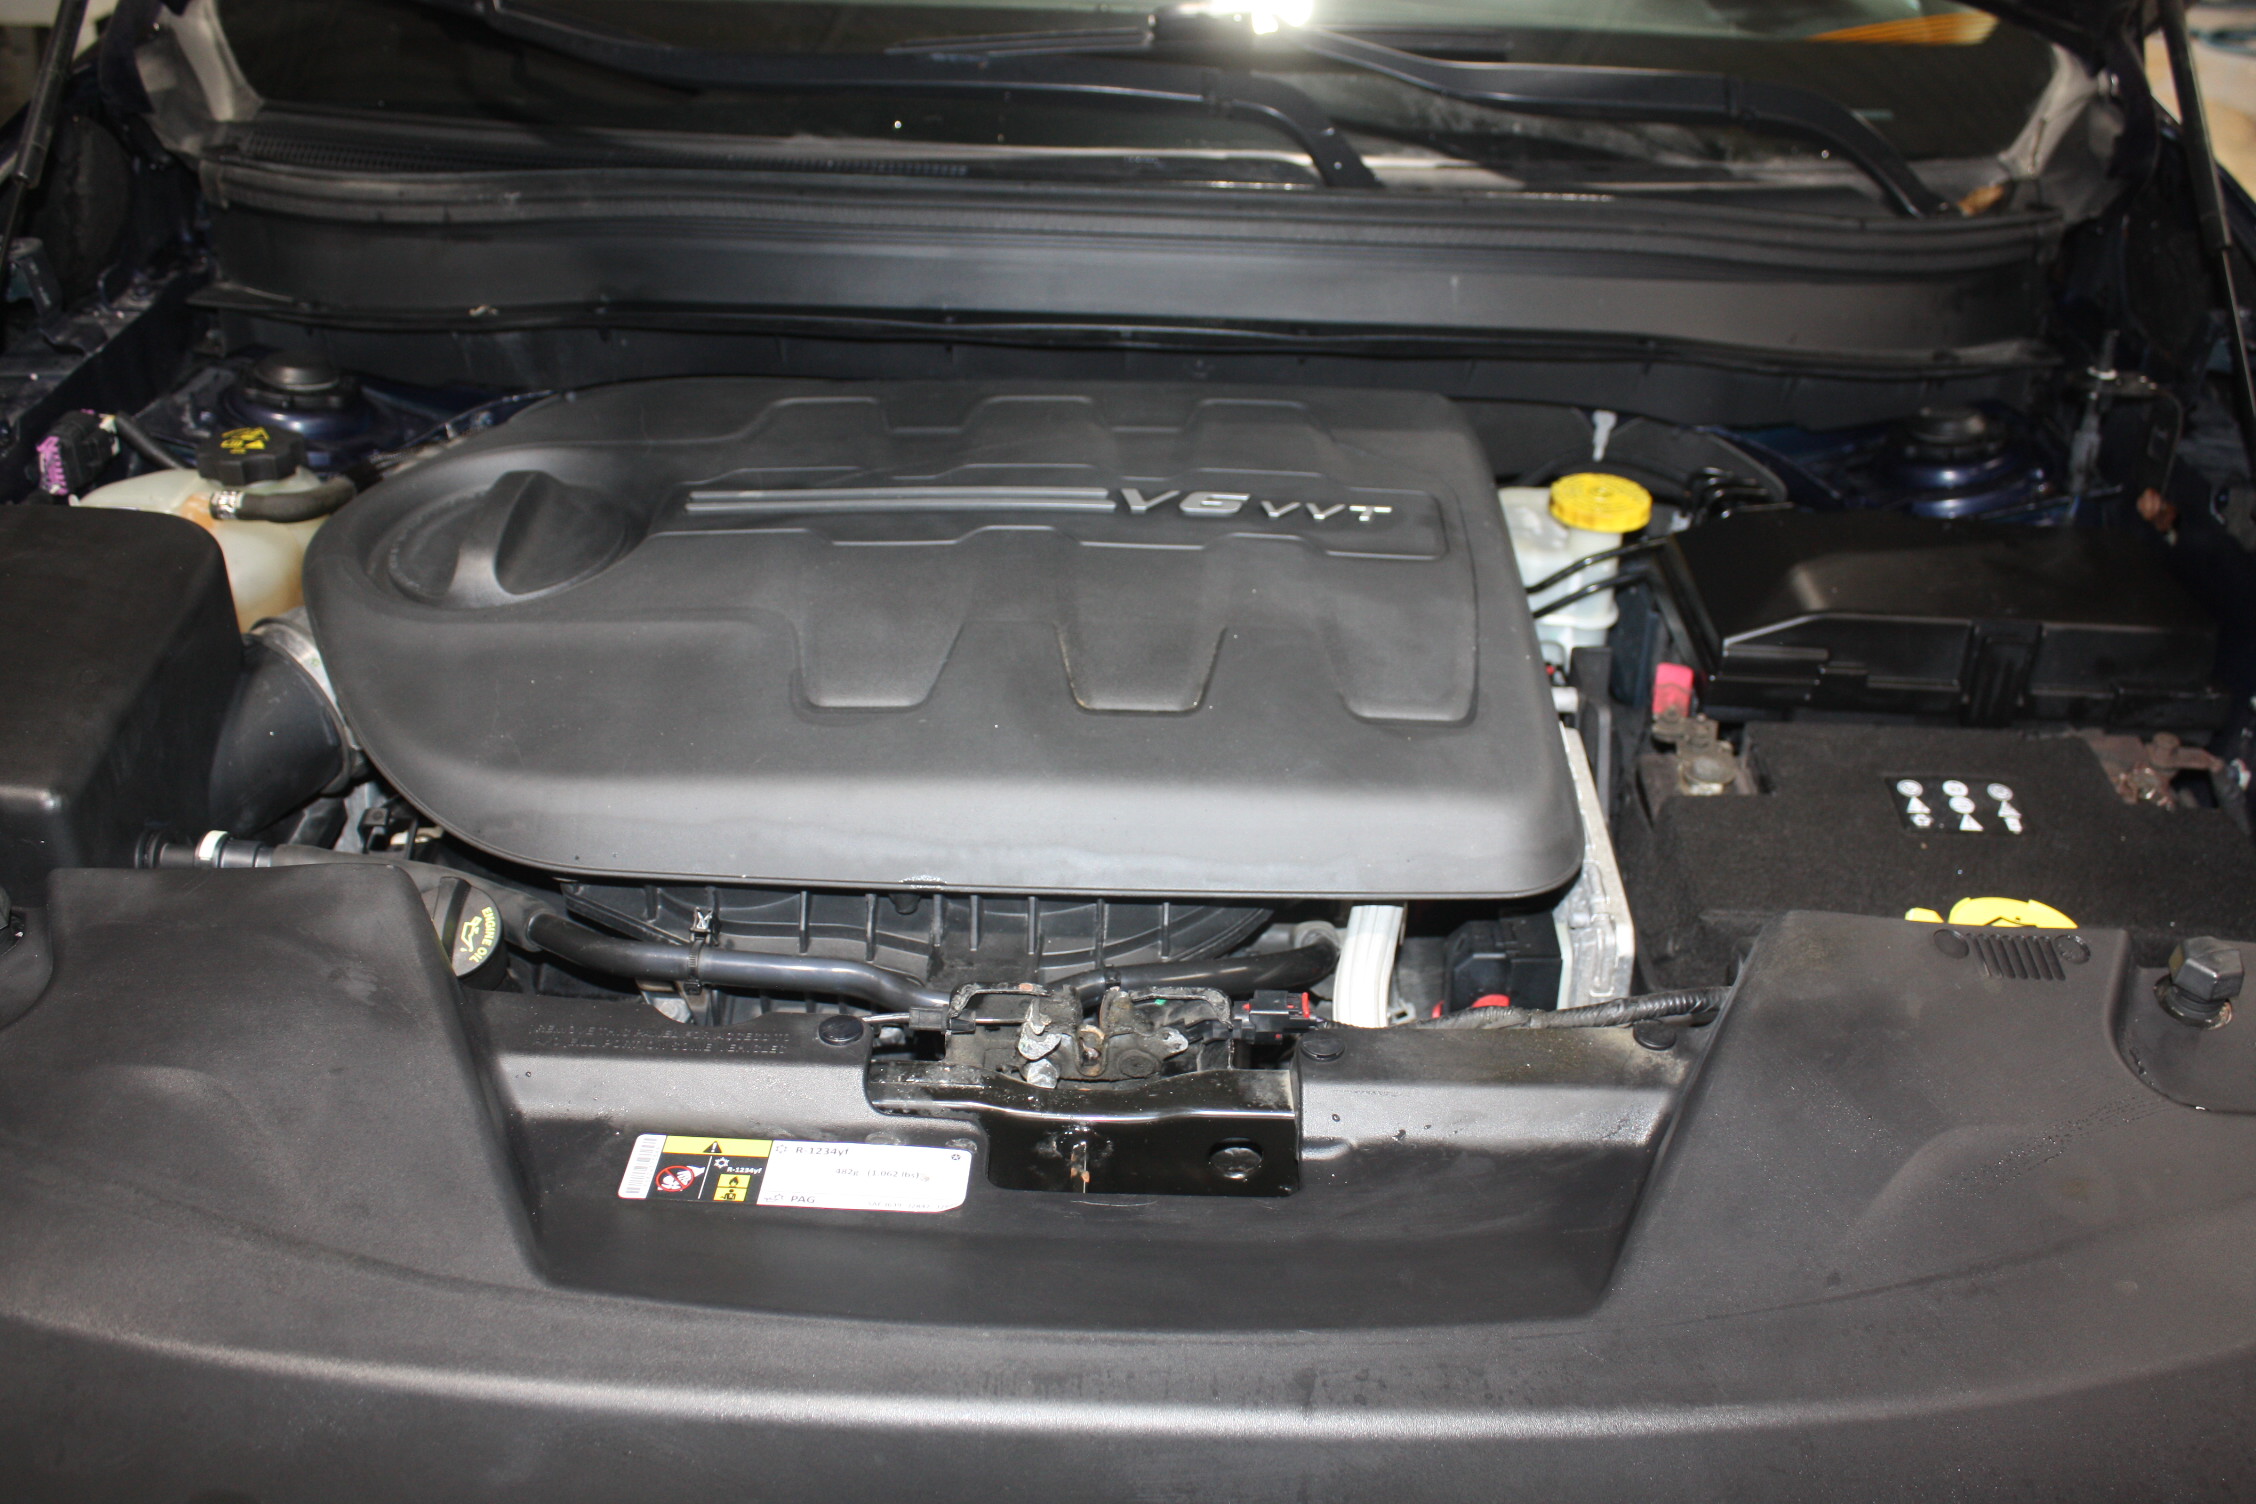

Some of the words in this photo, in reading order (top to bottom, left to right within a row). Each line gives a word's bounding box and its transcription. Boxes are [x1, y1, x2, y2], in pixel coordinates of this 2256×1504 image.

[1121, 487, 1251, 514] V6
[1260, 501, 1393, 522] VVT
[481, 906, 497, 947] ENGINE
[469, 946, 488, 963] OIL
[796, 1146, 849, 1157] R-1234yf
[727, 1166, 763, 1175] R-1234yf
[790, 1195, 815, 1204] PAG
